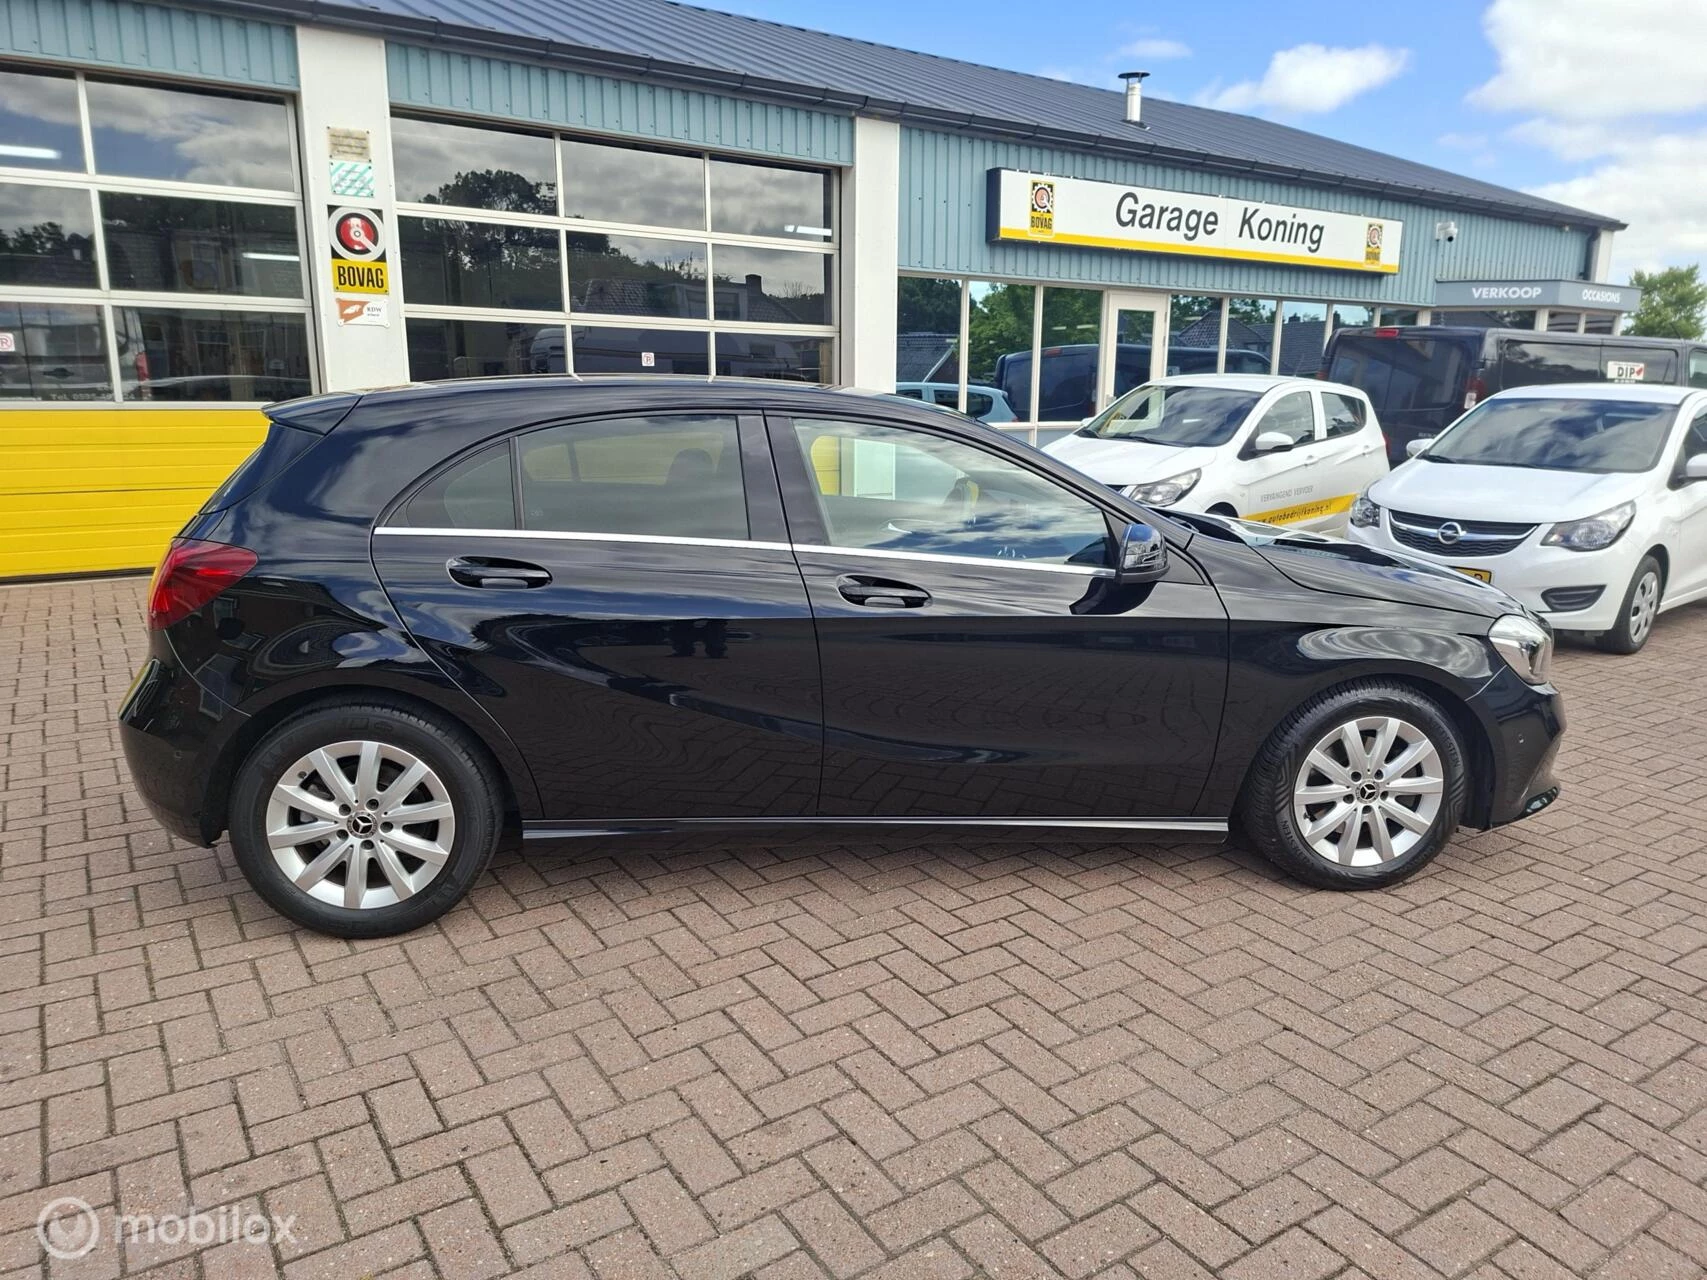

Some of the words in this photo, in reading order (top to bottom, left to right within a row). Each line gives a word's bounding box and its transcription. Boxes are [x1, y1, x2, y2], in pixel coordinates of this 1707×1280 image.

[1031, 216, 1052, 229] BOVAG
[1116, 192, 1218, 241] Garage
[1238, 207, 1324, 253] Koning
[337, 265, 384, 289] BOVAG
[1472, 287, 1542, 299] VERKOOP
[1582, 288, 1621, 304] OCCASIONS
[1617, 366, 1635, 378] DIP
